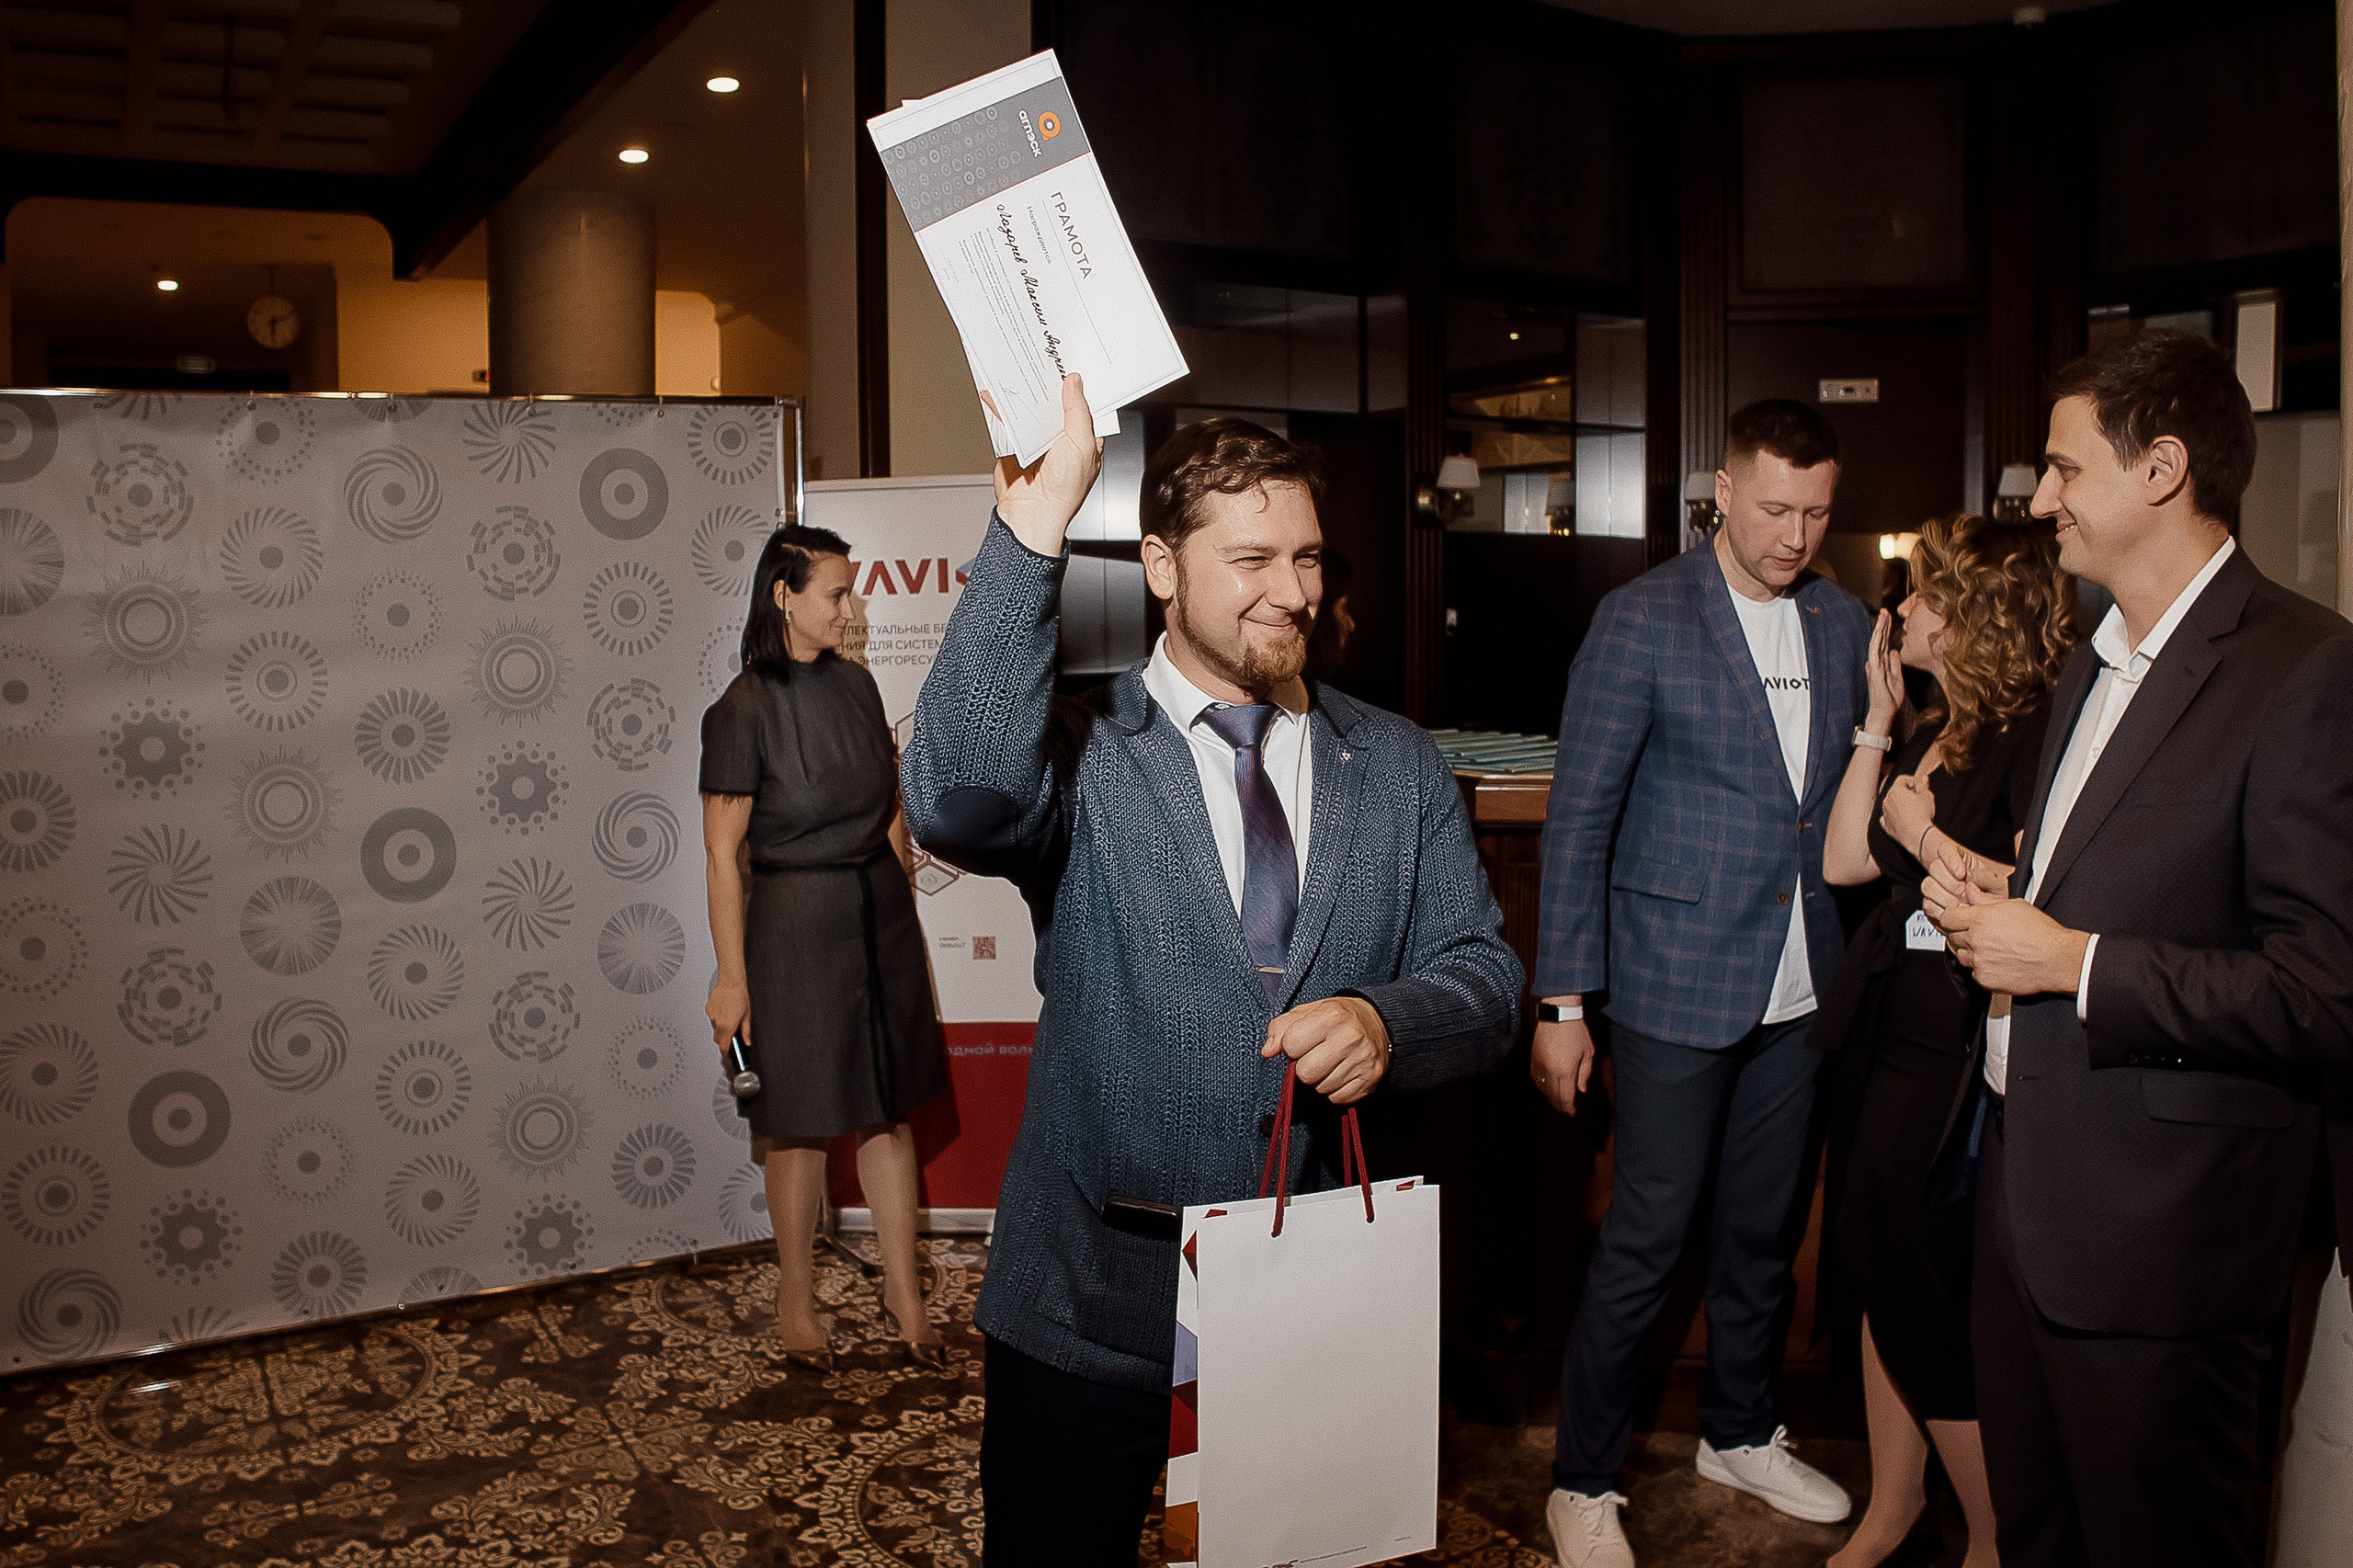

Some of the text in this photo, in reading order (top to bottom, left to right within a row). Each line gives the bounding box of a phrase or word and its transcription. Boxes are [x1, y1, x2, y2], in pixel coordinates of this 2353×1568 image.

[1027, 205, 1052, 264] Награждается
[1051, 191, 1092, 279] ГРАМОТА
[996, 203, 1028, 264] Лазарев
[1020, 268, 1048, 326] Максим
[1043, 329, 1067, 381] Андрее
[846, 623, 930, 636] ЛЕКТУАЛЬНЫЕ
[868, 641, 893, 652] ДЛЯ
[858, 654, 936, 666] ЭНЕРГОРЕСУ
[1764, 676, 1810, 690] AVIOT
